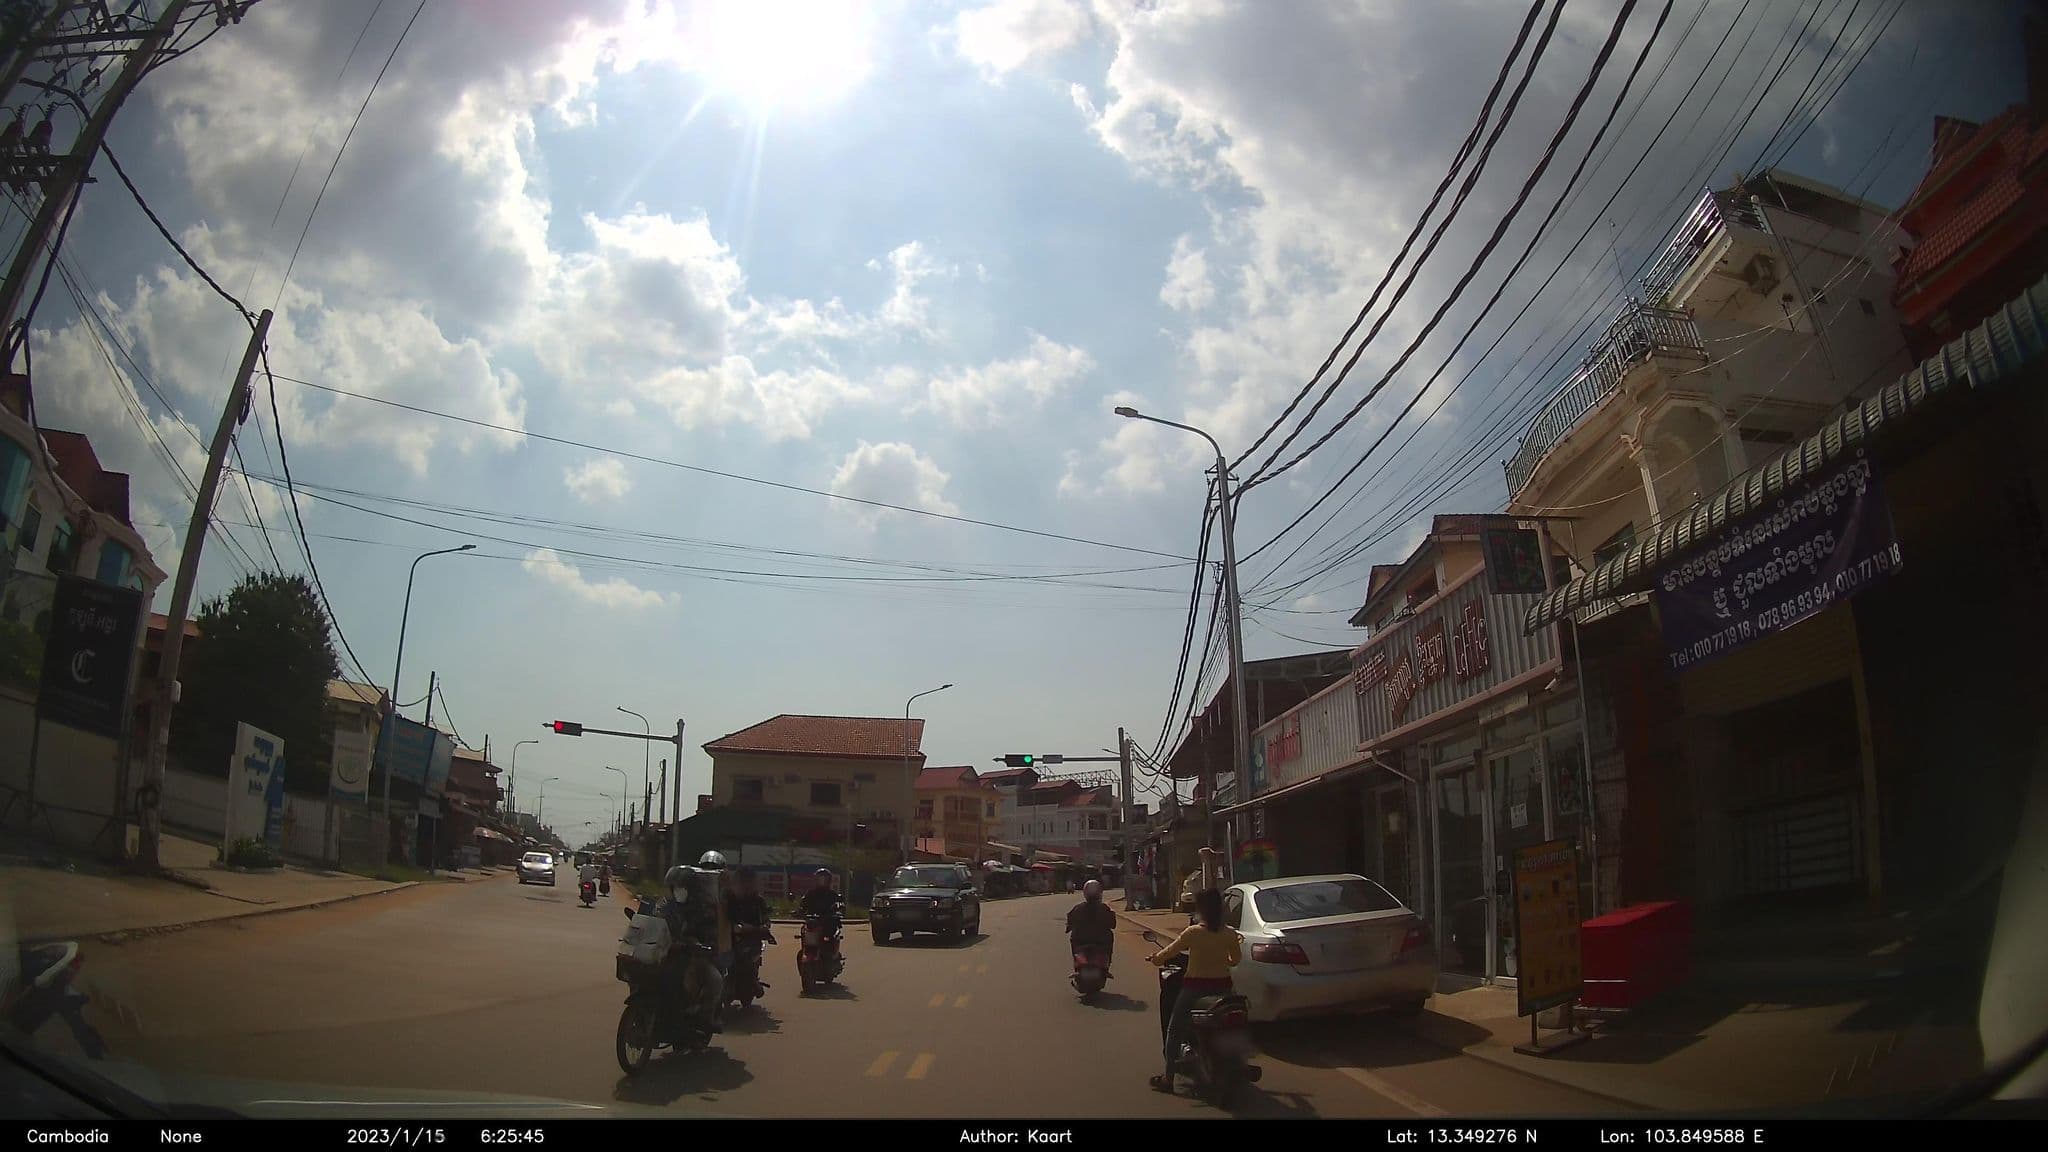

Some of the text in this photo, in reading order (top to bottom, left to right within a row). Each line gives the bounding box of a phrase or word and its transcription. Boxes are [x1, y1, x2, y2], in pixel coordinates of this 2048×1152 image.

[1694, 638, 1711, 656] 010
[1758, 611, 1780, 631] 078
[1780, 600, 1797, 621] 96
[1797, 591, 1814, 613] 93
[1836, 569, 1858, 593] 010
[1889, 543, 1901, 563] 18
